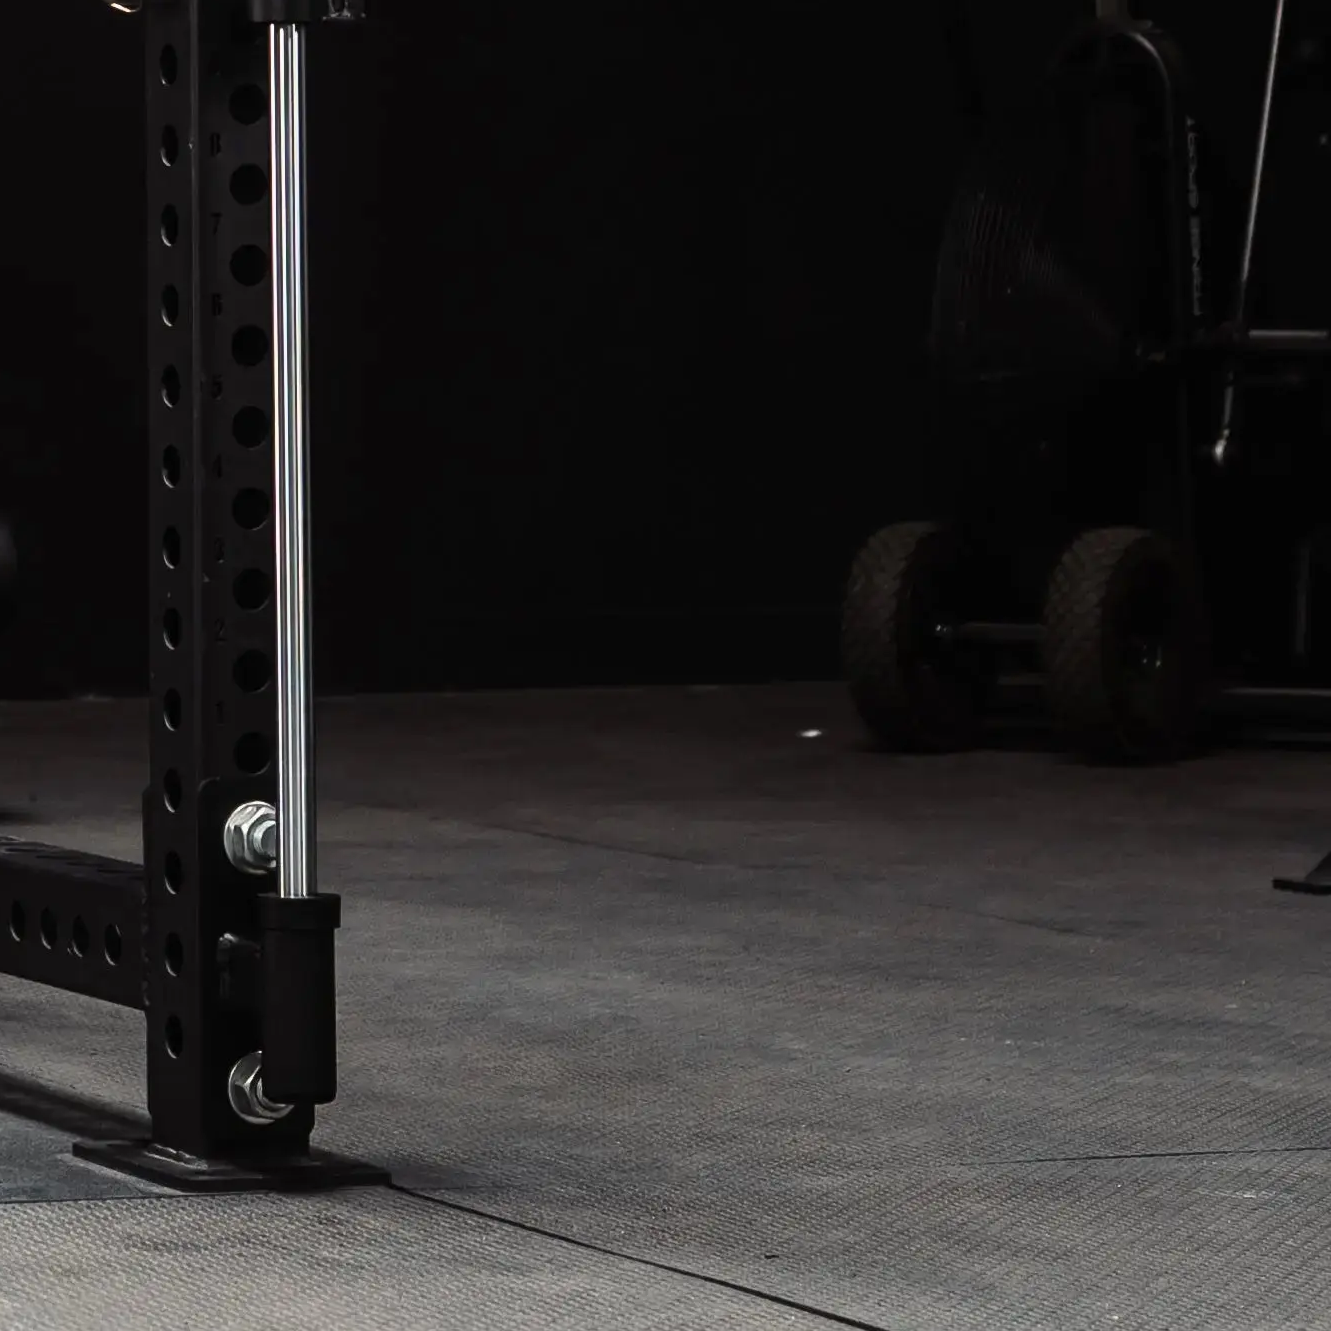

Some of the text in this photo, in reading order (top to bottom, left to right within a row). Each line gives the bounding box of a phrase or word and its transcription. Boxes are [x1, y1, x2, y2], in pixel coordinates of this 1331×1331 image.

[210, 211, 223, 236] 7
[211, 292, 224, 317] 6
[210, 374, 223, 400] 5
